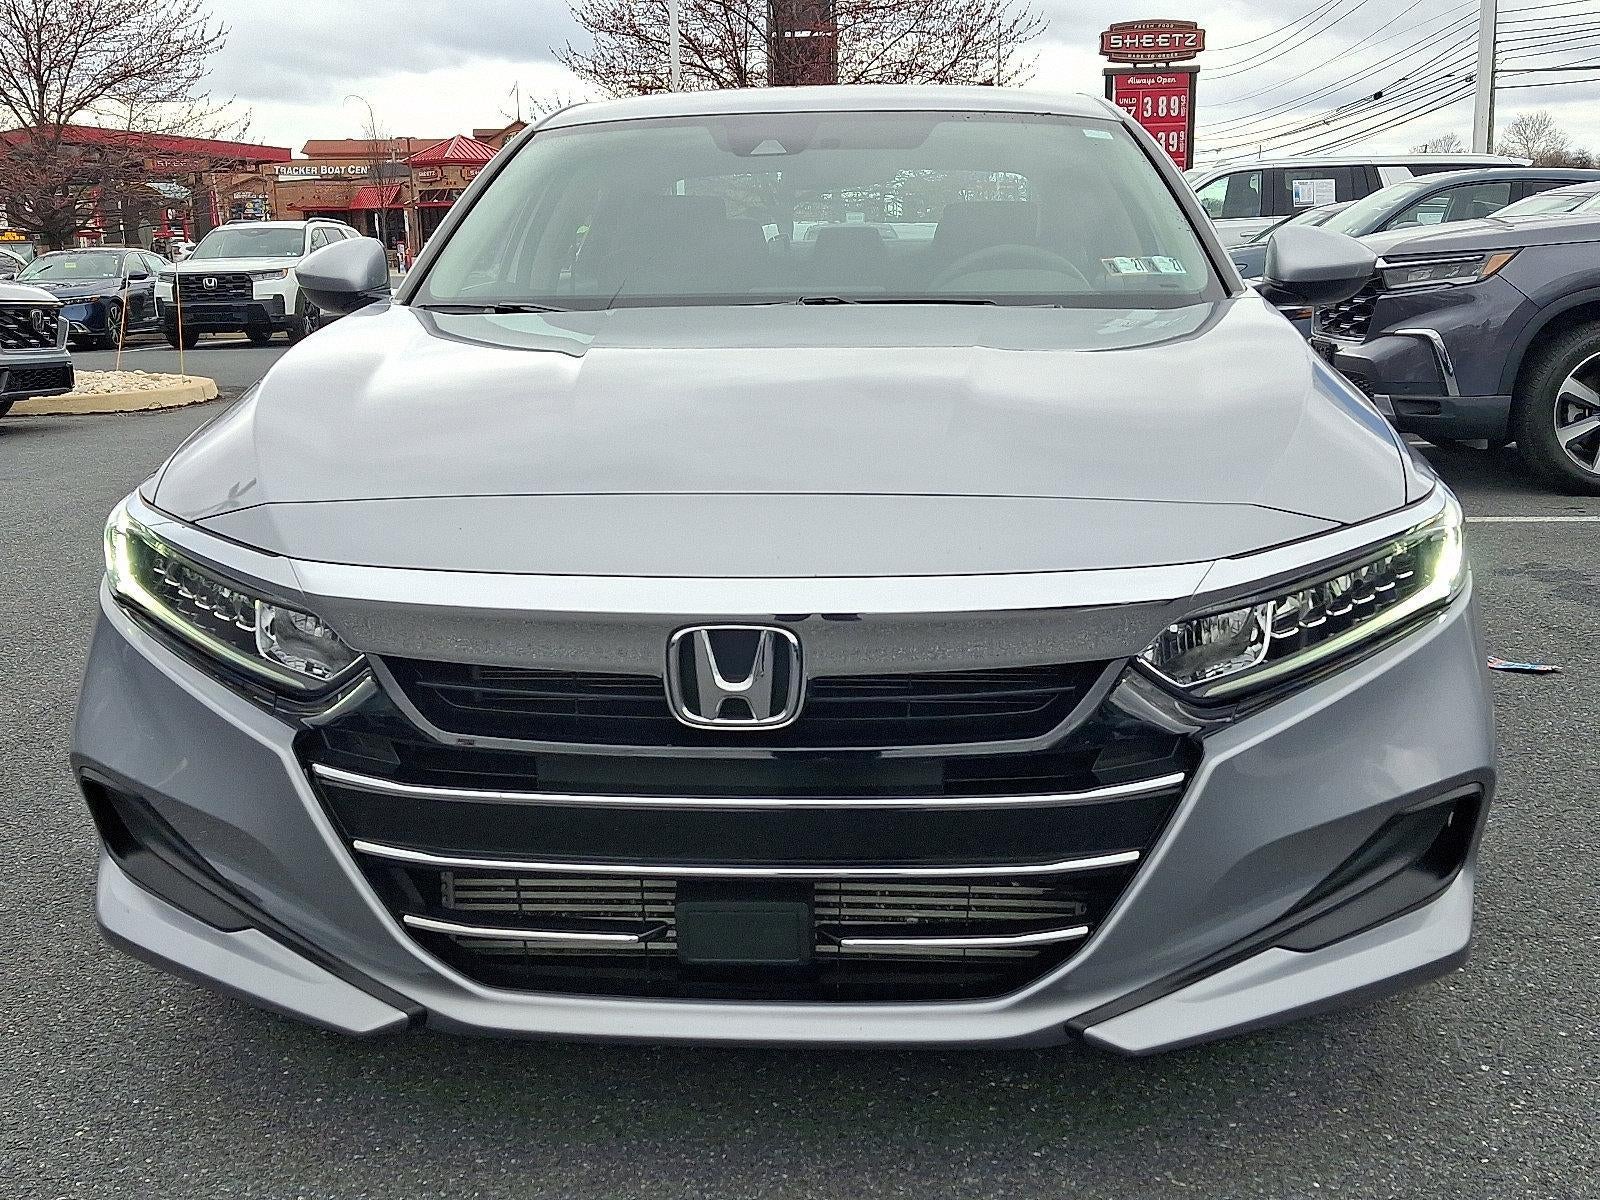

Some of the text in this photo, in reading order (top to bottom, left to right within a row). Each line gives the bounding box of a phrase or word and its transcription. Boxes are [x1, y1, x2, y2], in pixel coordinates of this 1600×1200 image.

[1110, 34, 1196, 48] SHEETZ
[1128, 76, 1176, 86] Always Open
[1143, 96, 1179, 117] 3.89
[273, 164, 371, 175] TRACKER BOAT CEN
